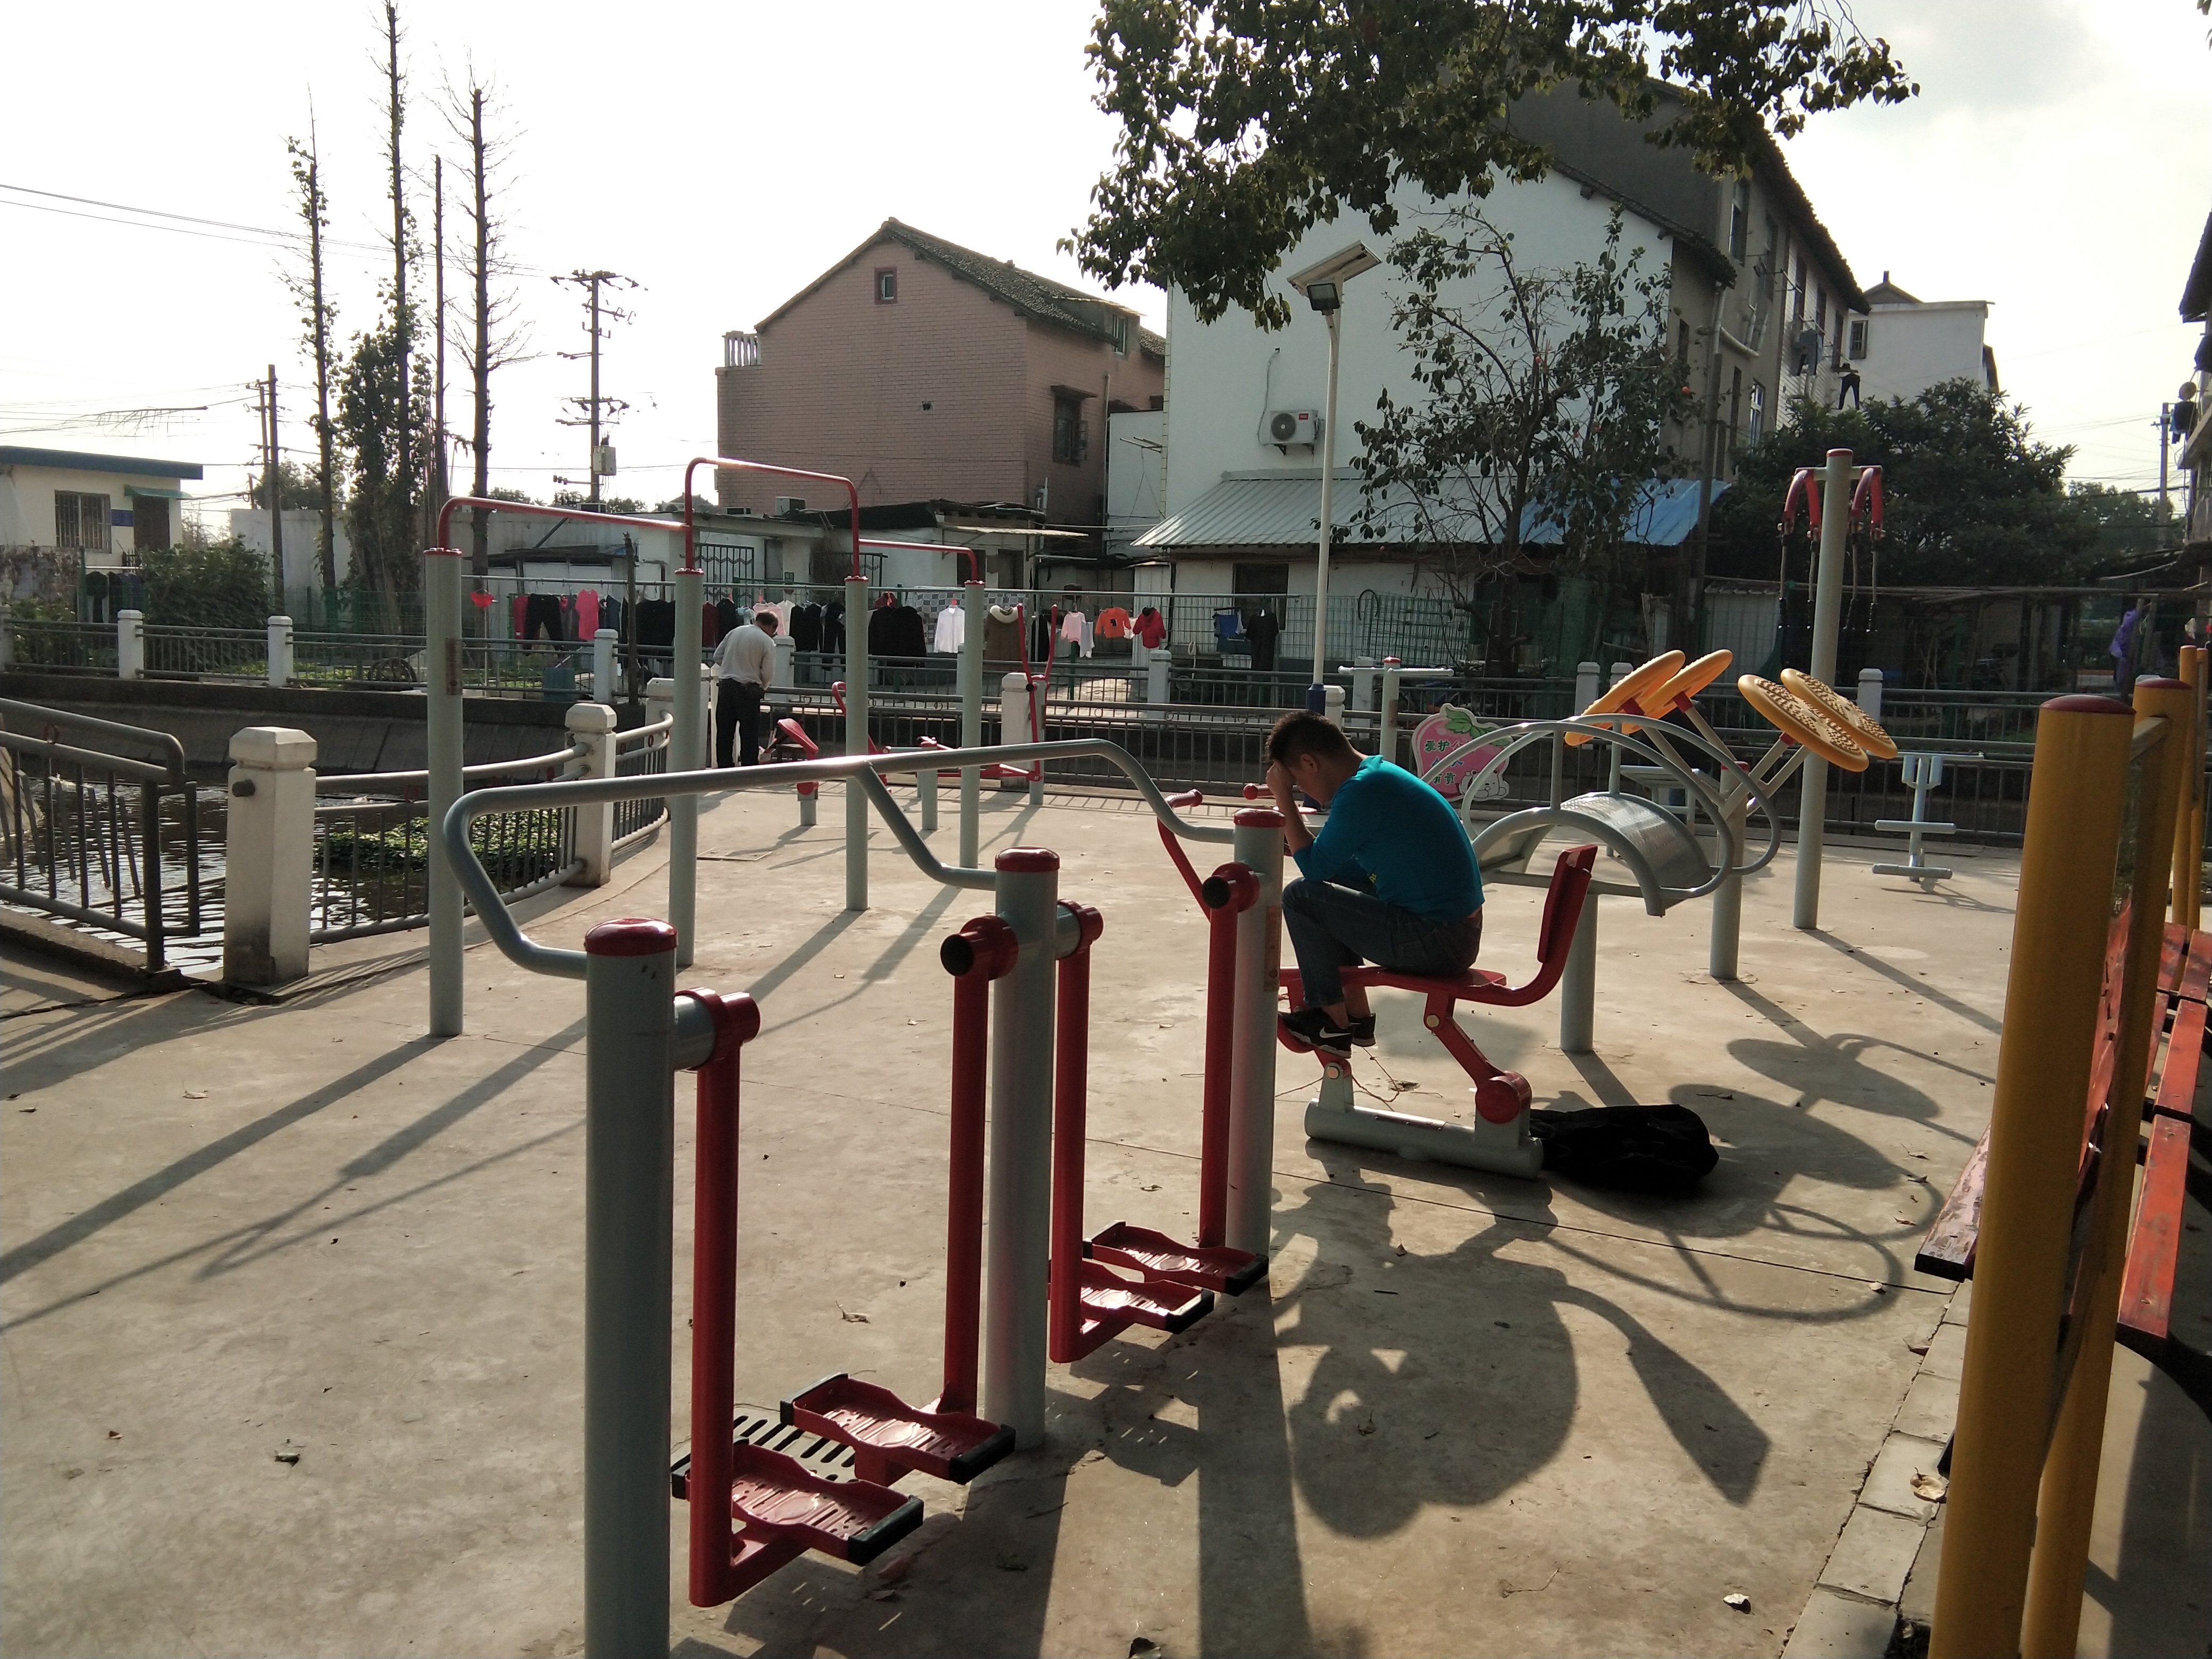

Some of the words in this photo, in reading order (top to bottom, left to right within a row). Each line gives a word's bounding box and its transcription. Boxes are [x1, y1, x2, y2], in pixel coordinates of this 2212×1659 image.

[1425, 740, 1476, 752] 爱护公
[1433, 773, 1455, 784] 有责
